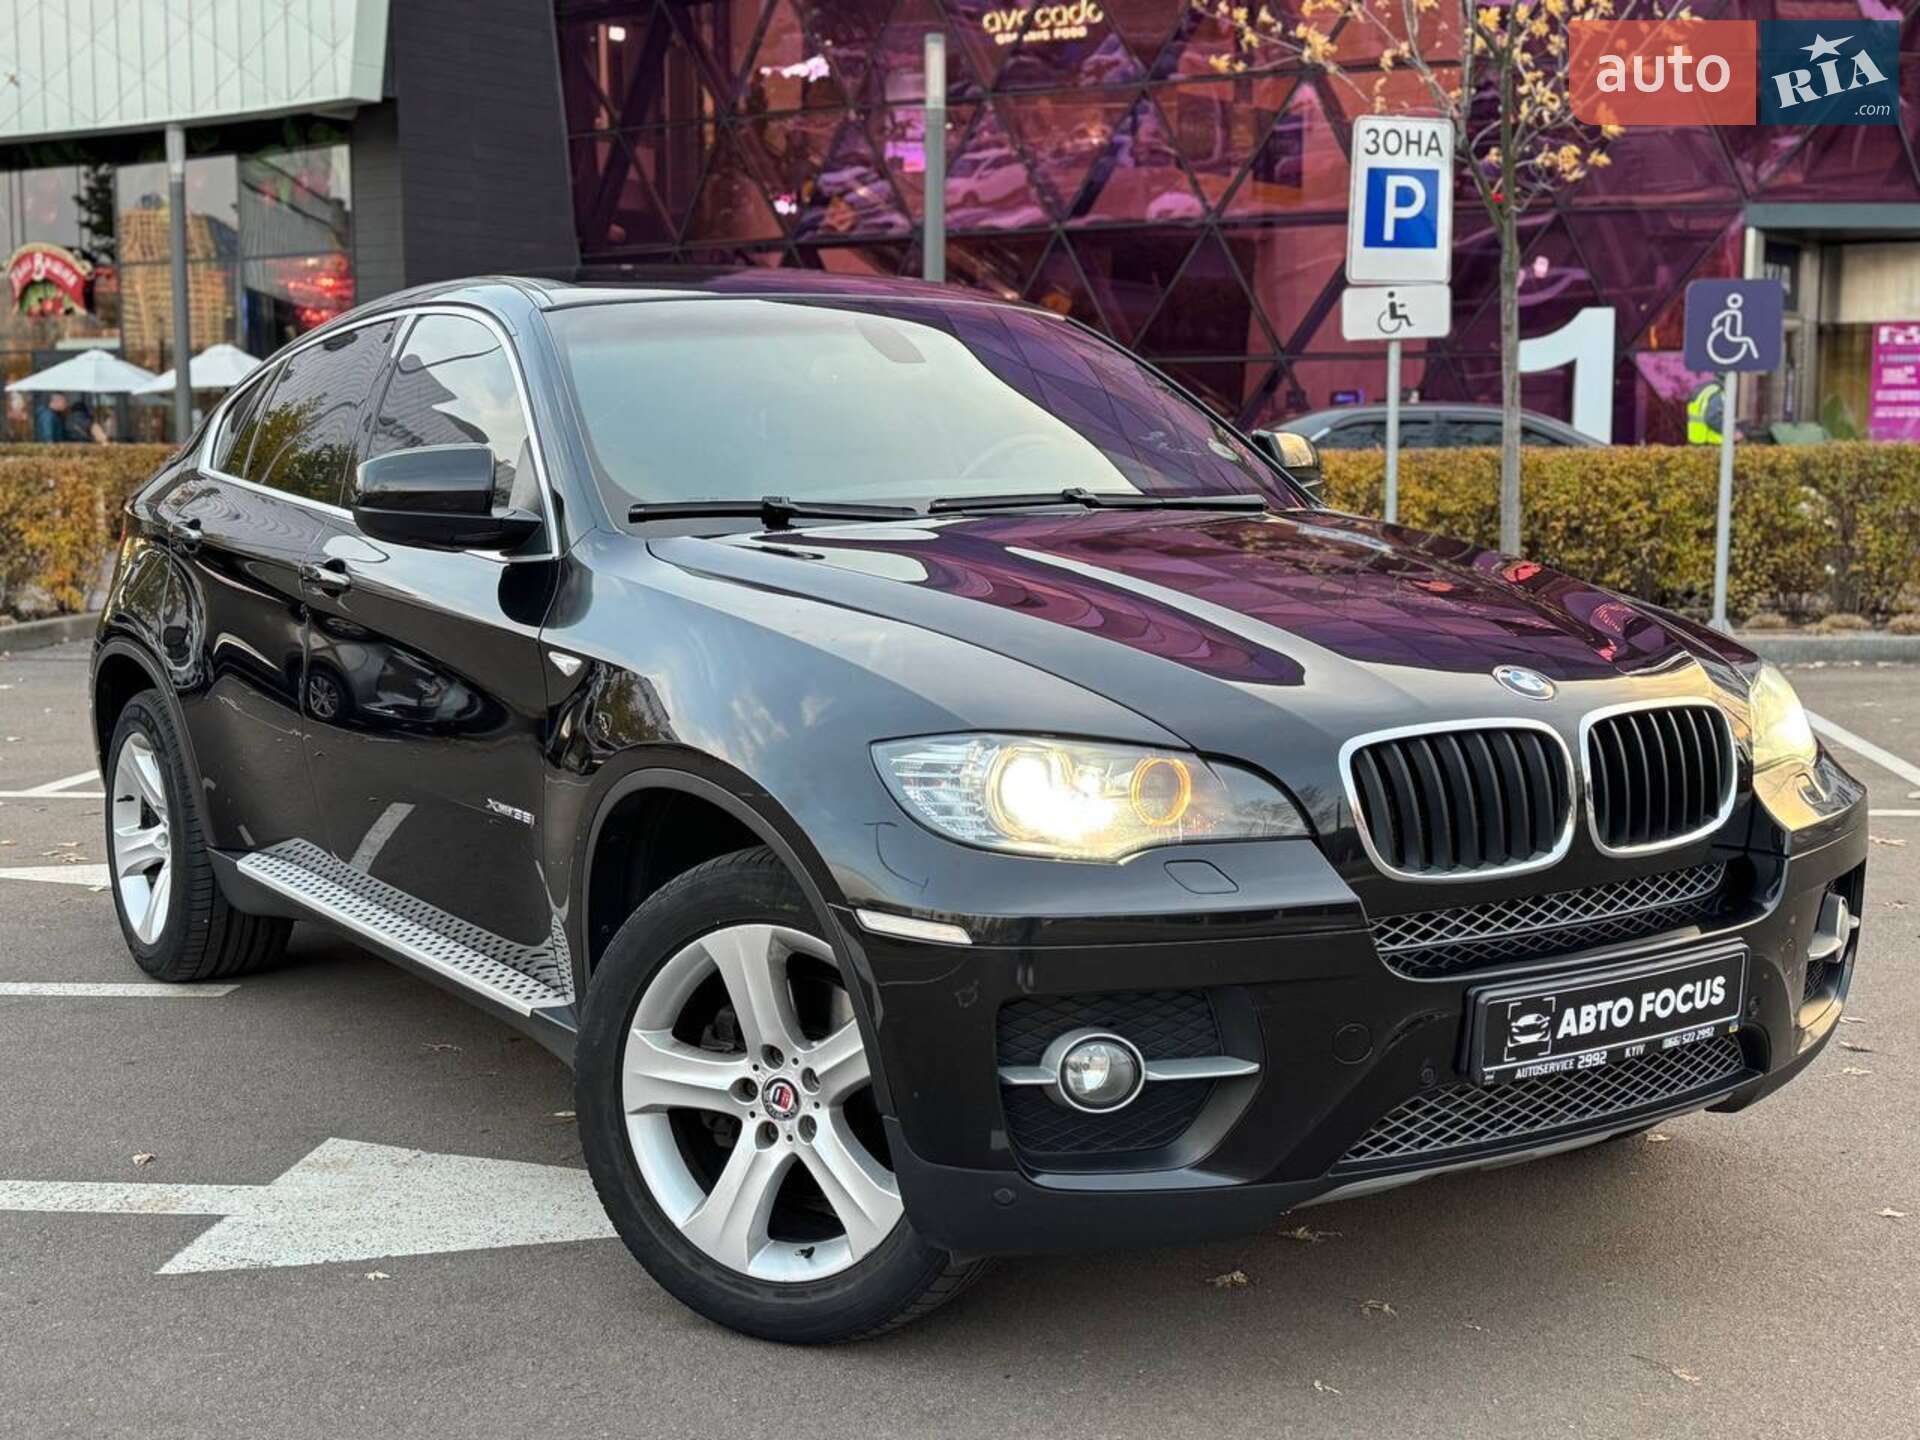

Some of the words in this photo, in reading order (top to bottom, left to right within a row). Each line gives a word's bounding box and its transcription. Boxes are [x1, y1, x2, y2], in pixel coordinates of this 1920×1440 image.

[1364, 128, 1443, 157] ЗОНА
[1383, 174, 1426, 241] P
[1639, 975, 1726, 1023] FOCUS
[1515, 1058, 1575, 1079] AUTOSERVICE
[1577, 1050, 1608, 1069] 2992
